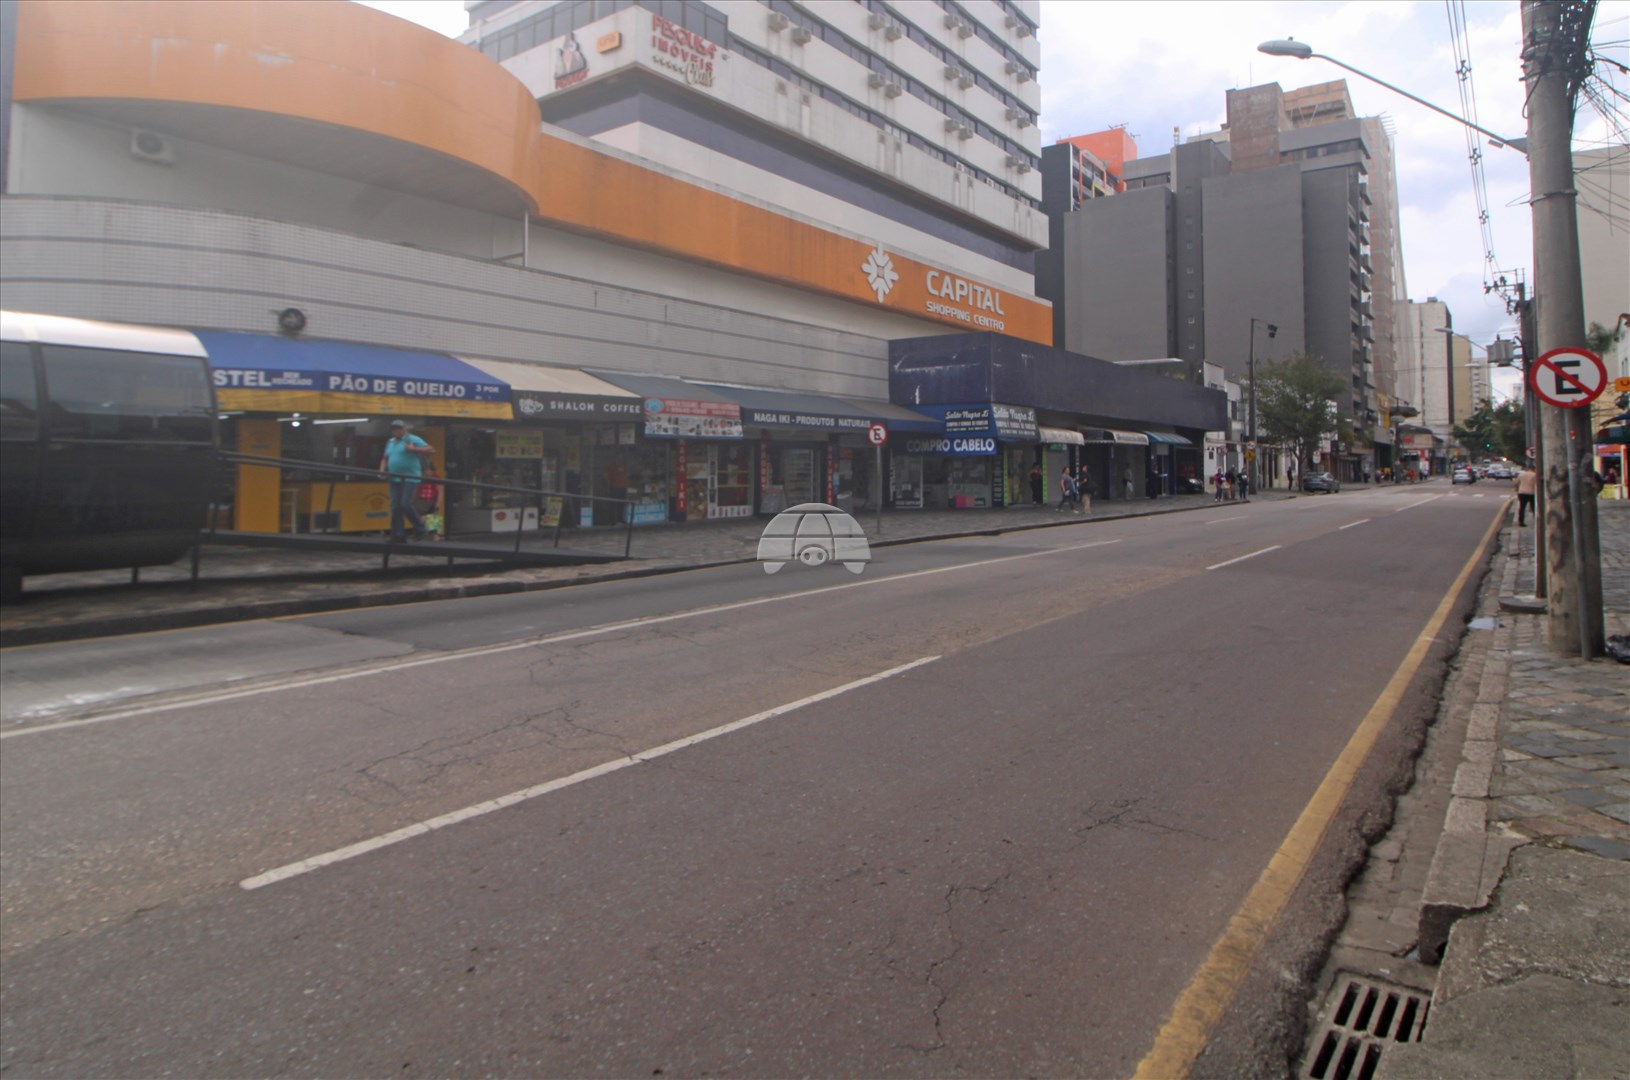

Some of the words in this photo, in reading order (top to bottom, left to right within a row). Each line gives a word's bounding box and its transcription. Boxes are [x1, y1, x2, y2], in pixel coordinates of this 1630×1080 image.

[926, 270, 1005, 315] CAPITAL
[926, 301, 970, 322] SHOPPING
[973, 313, 1005, 331] CENTRO
[212, 369, 272, 387] STEL
[329, 374, 369, 391] PÃO
[373, 379, 397, 393] DE
[403, 381, 466, 398] QUEIJO
[1555, 360, 1583, 395] E
[550, 400, 595, 412] SHALOM
[603, 403, 641, 414] COFFEE
[753, 412, 777, 423] NAGA
[779, 414, 791, 424] IKI
[796, 415, 835, 427] PRODUTOS
[838, 418, 872, 428] NATURAIS
[907, 440, 951, 452] COMPRO
[953, 438, 995, 452] CABELO
